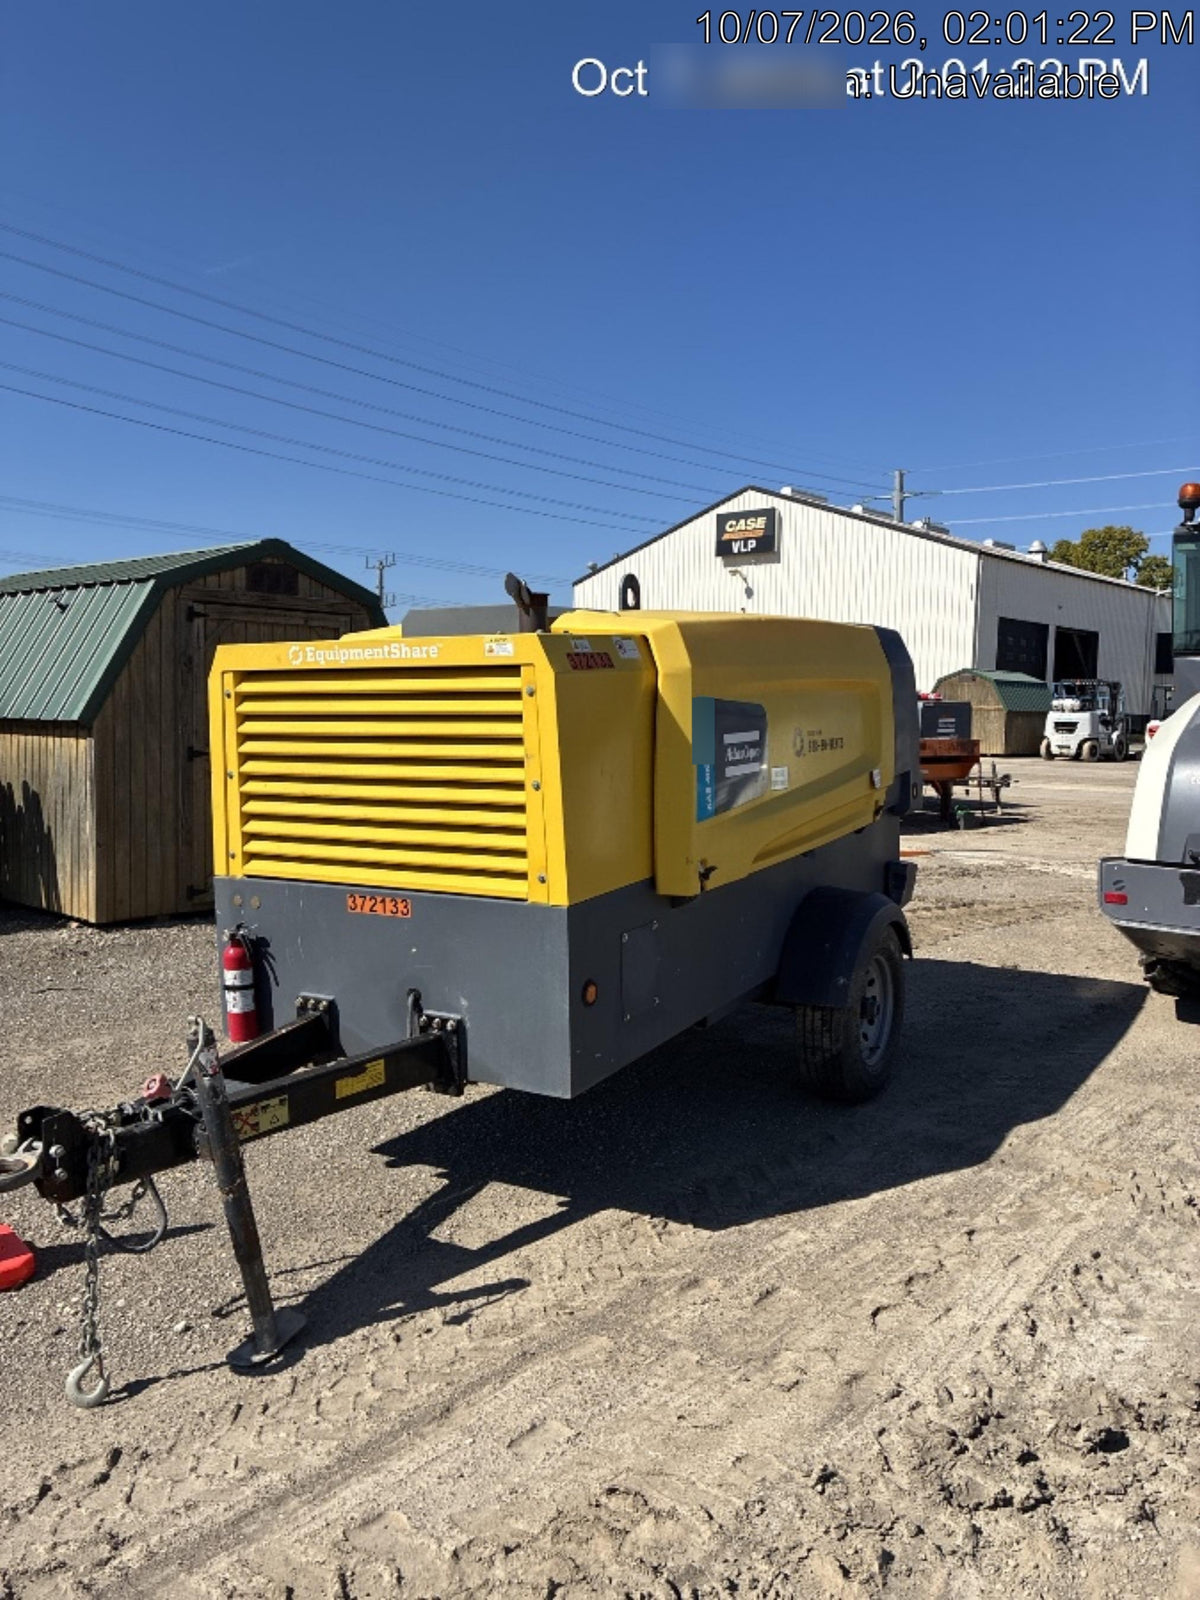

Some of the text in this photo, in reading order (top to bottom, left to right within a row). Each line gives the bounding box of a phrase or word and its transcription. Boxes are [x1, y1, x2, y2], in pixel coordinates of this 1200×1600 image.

[725, 516, 767, 532] CASE
[731, 539, 756, 553] VLP
[305, 642, 438, 664] EquipmentShare
[348, 894, 410, 917] 372133
